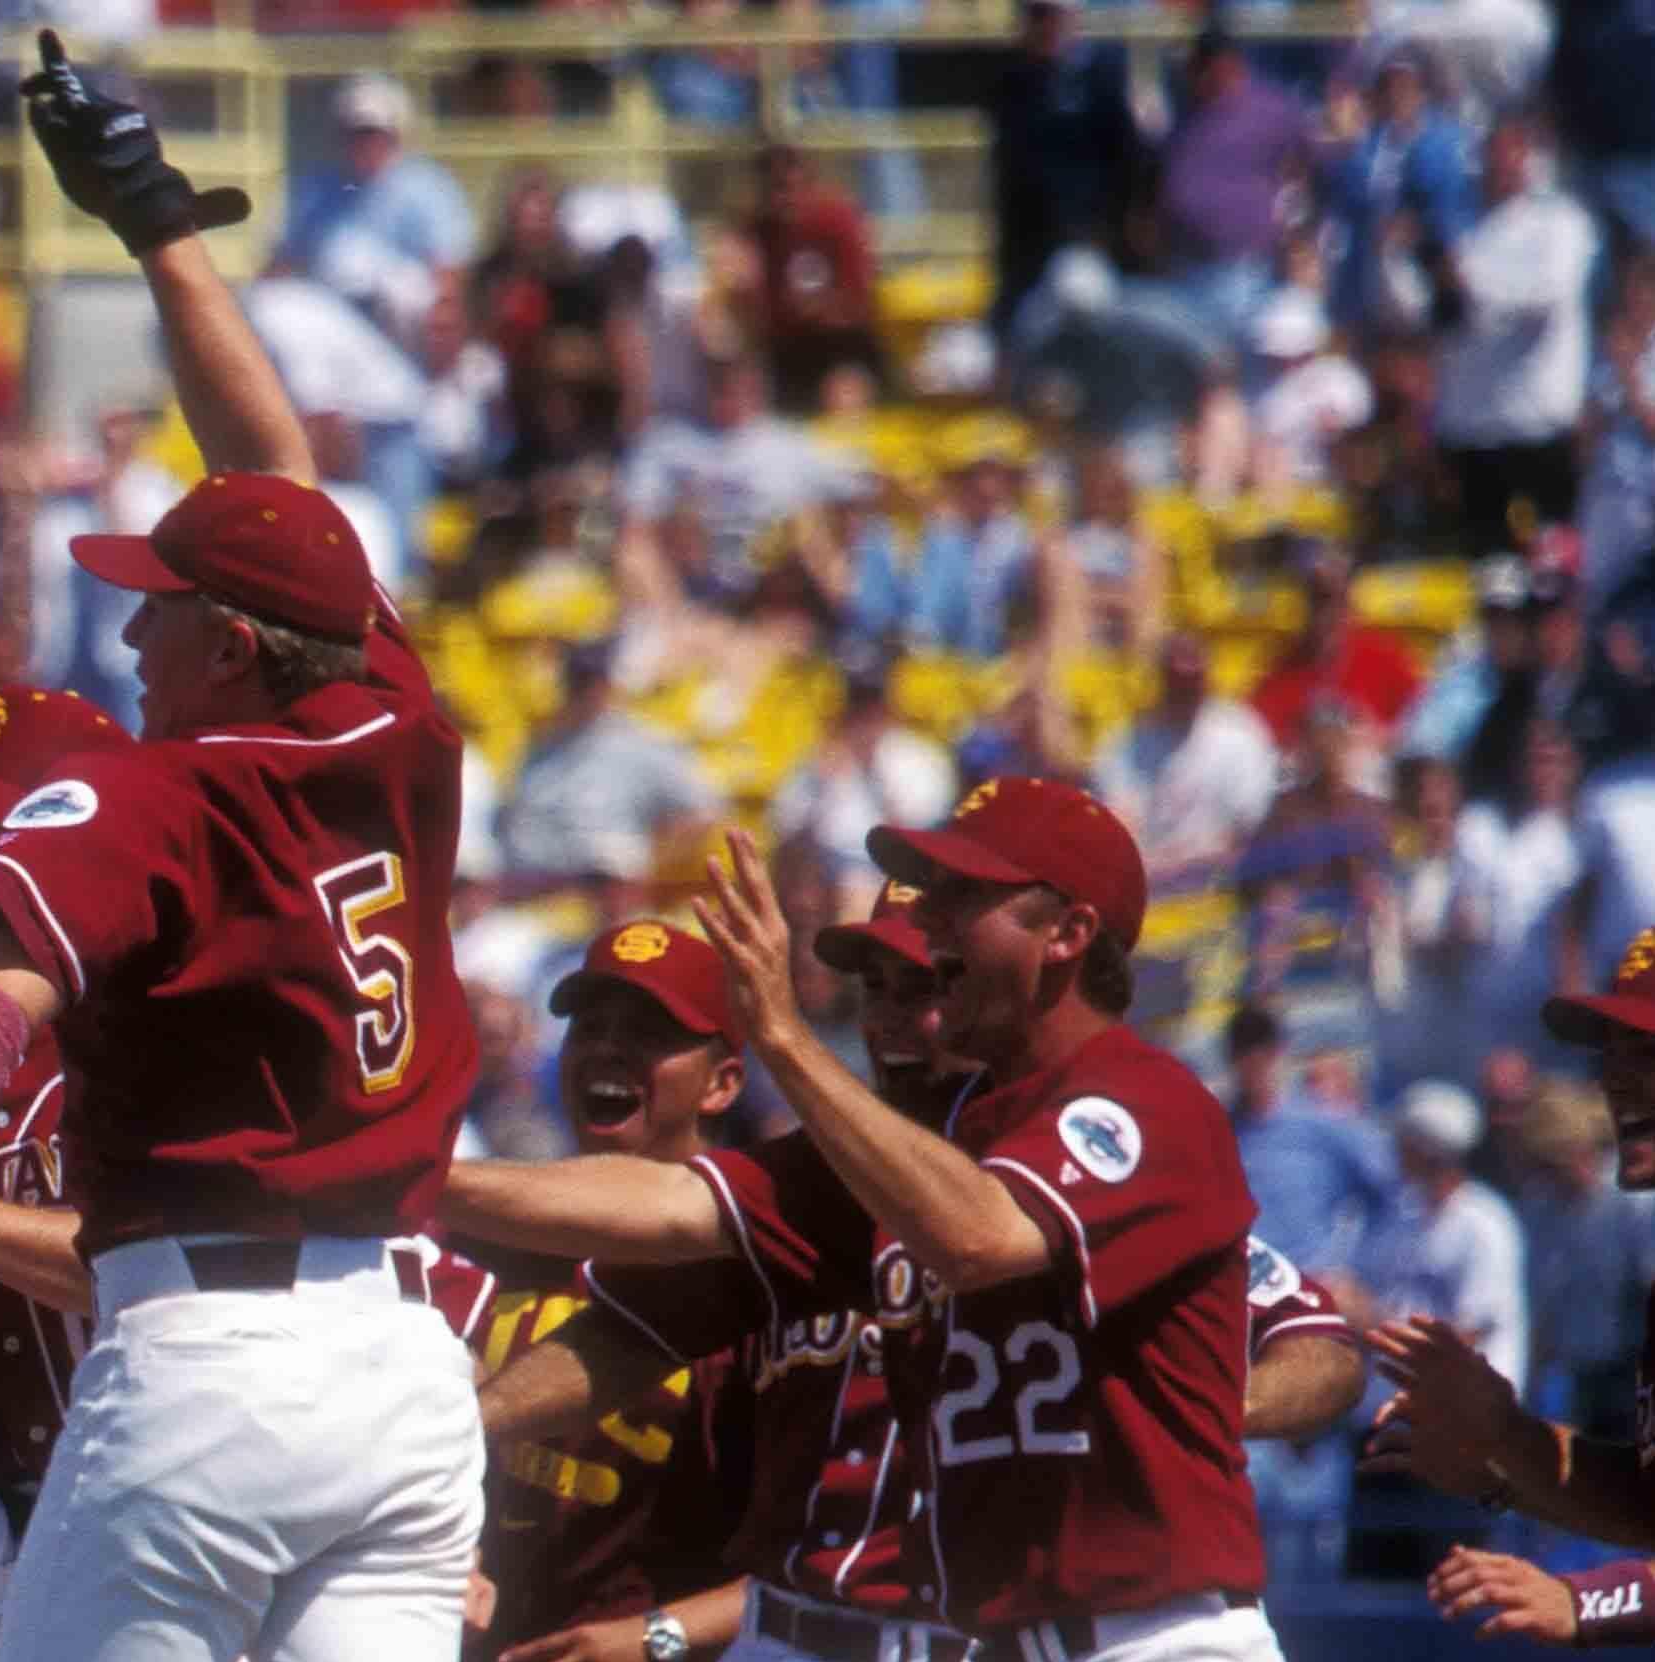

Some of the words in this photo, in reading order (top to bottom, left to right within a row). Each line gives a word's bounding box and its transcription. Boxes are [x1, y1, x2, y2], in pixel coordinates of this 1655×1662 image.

[313, 850, 415, 1095] 5
[931, 1320, 1090, 1467] 22
[1578, 1581, 1644, 1621] TPX
